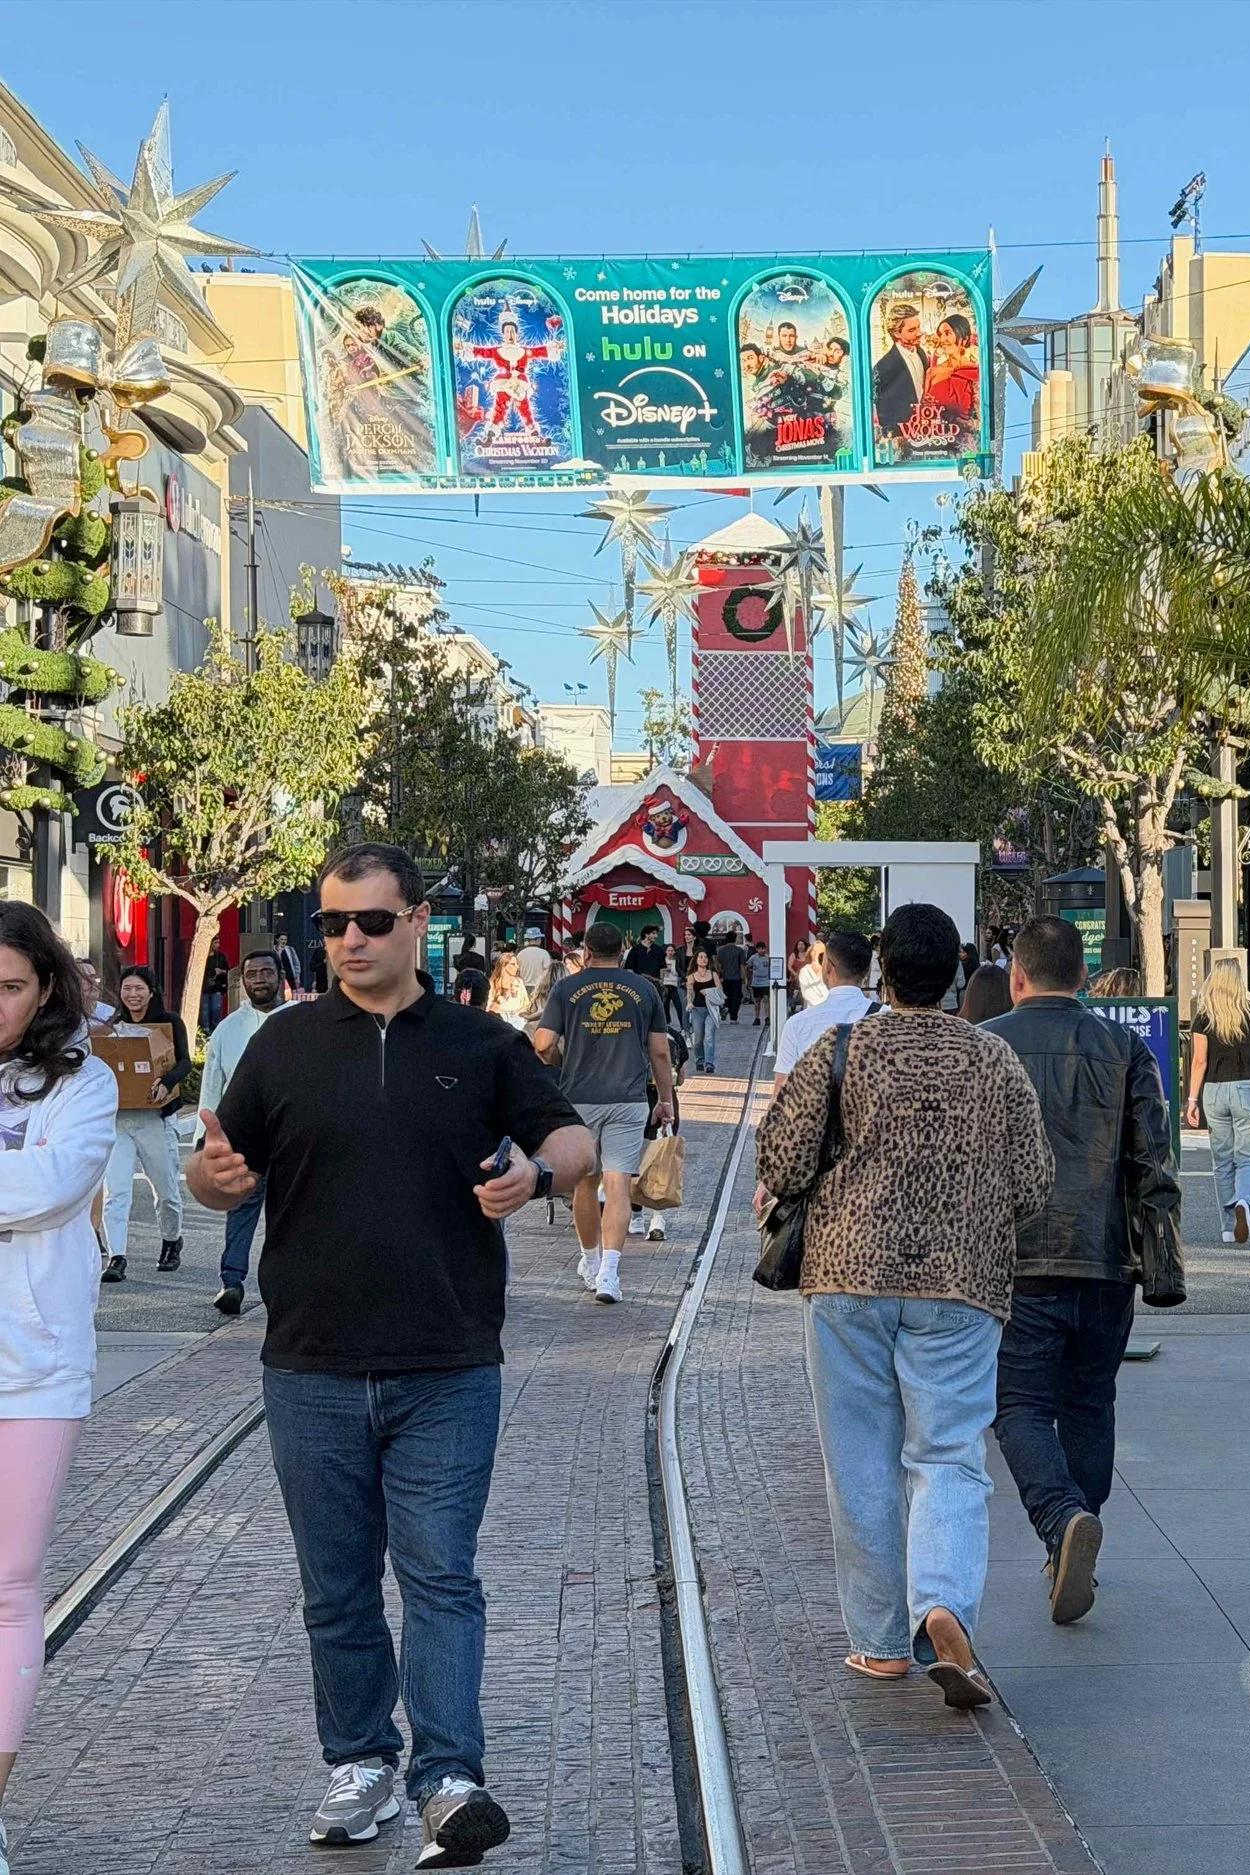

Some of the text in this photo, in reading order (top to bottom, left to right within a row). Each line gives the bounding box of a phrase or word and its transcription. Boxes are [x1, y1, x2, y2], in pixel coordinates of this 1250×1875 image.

[474, 296, 496, 306] hulu
[574, 286, 721, 301] Come home for the
[892, 290, 913, 299] hulu
[601, 304, 699, 328] Holidays
[601, 336, 706, 361] hulu ON
[911, 403, 945, 424] JOY
[356, 423, 402, 435] PERCY
[775, 416, 824, 446] JONAS
[897, 423, 960, 438] WORLD
[344, 434, 415, 451] JACKSON
[776, 437, 825, 452] CHRISTMAS MOVIE
[475, 444, 560, 457] CHRISTMAS VACATION
[88, 833, 151, 845] Backcry
[608, 893, 645, 907] Enter
[1074, 920, 1106, 930] CONGRATS
[1190, 938, 1198, 996] DIRECTO
[569, 982, 642, 1005] RECRUITERS SCHOOL
